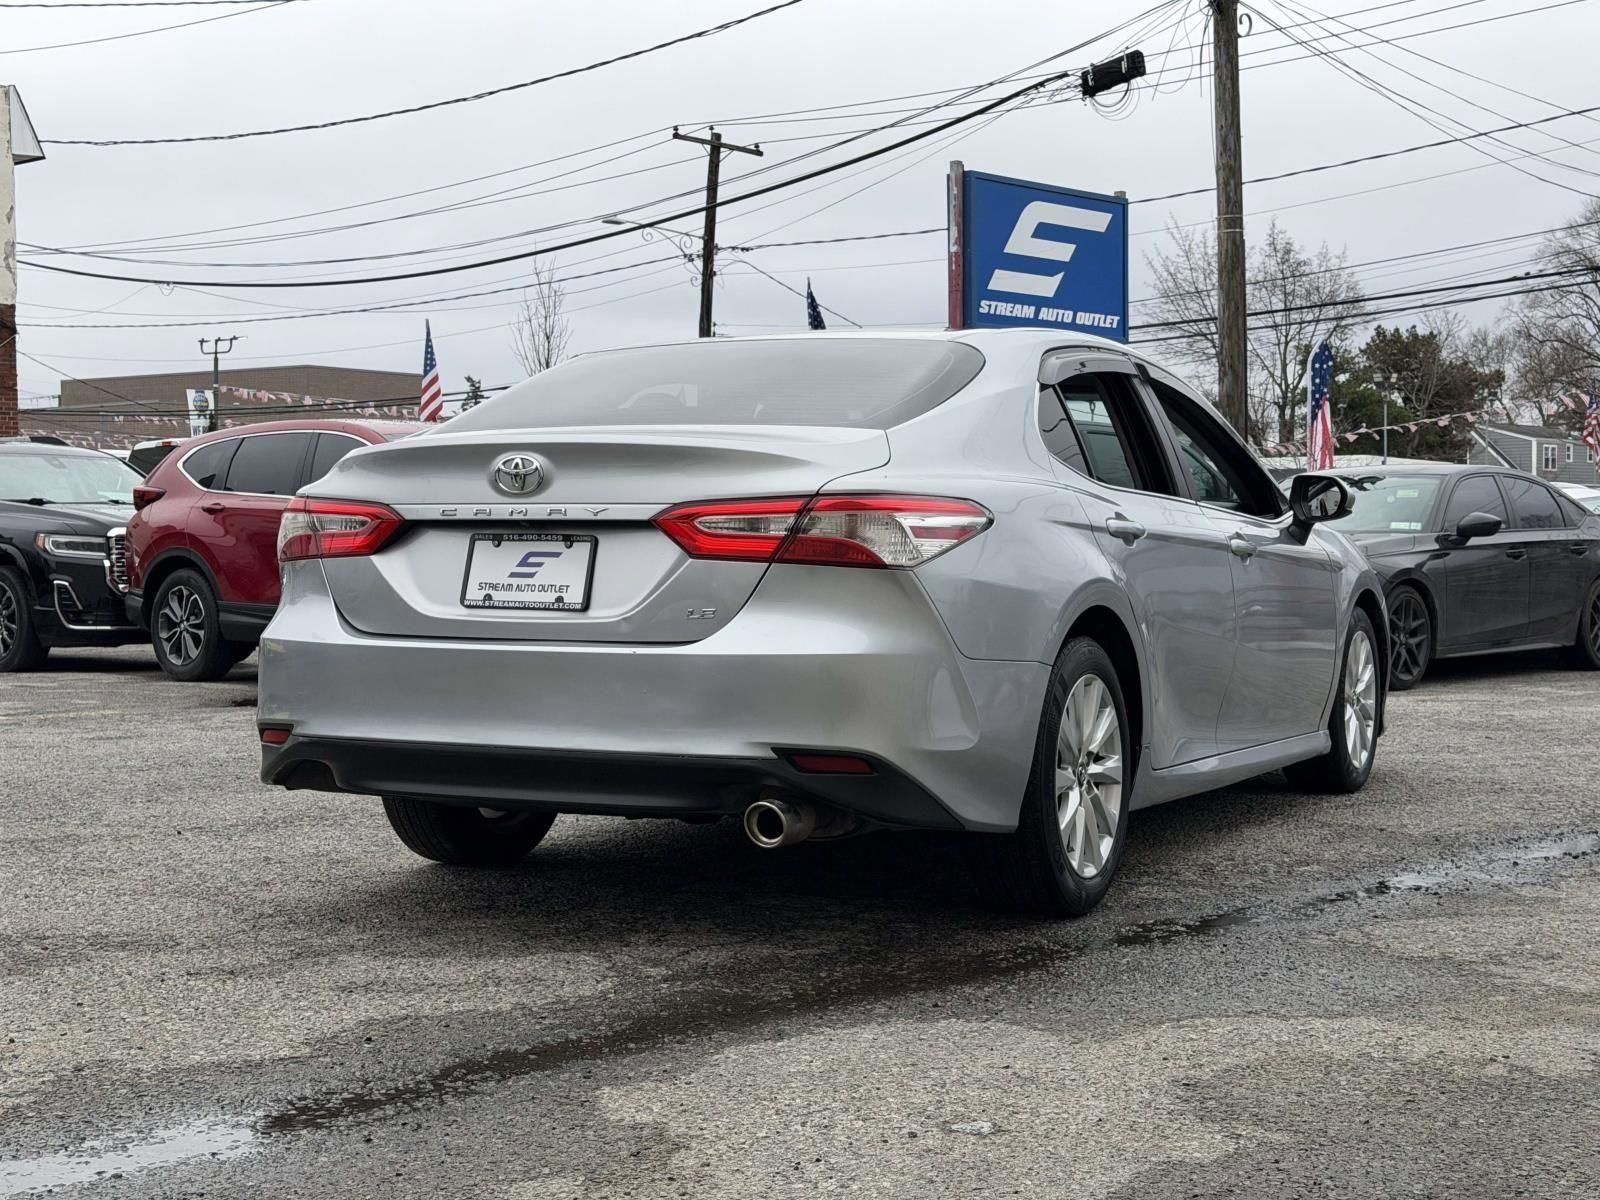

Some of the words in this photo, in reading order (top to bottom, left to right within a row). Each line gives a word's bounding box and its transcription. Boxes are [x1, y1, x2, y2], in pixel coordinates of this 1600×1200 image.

[979, 300, 1036, 319] STREAM
[1038, 307, 1074, 323] AUTO
[1075, 311, 1120, 328] OUTLET
[439, 507, 609, 517] CAMRY
[477, 582, 513, 593] STREAM
[514, 583, 537, 593] AUTO
[537, 584, 570, 594] OUTLET
[463, 599, 582, 609] WWW.STREAMAUTOOUTLET.COM
